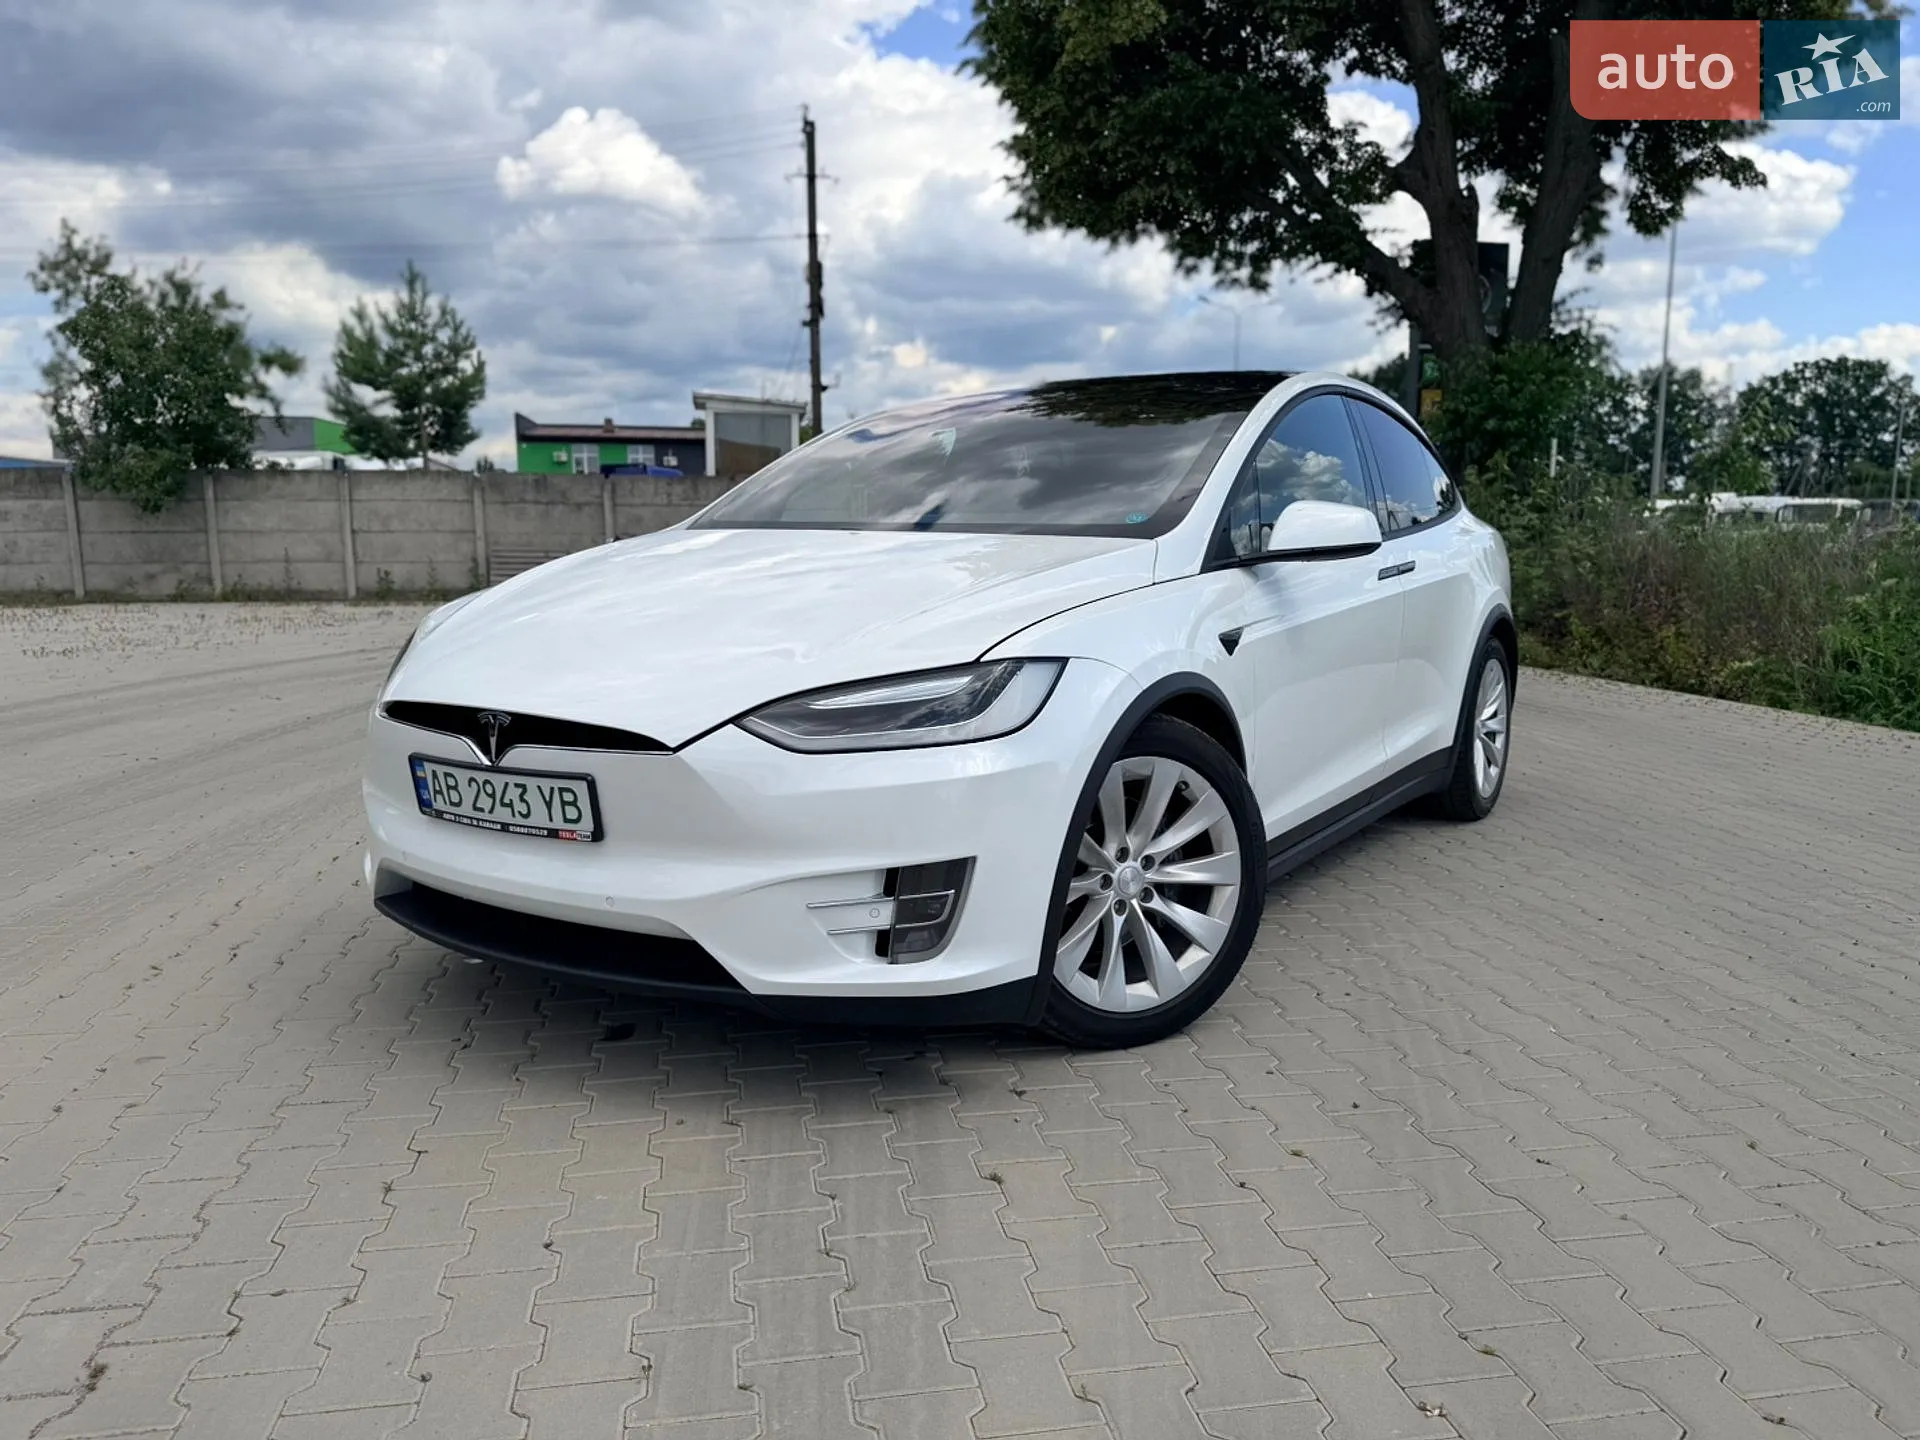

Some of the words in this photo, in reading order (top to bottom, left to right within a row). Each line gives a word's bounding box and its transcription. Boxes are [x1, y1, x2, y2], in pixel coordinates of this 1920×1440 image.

[431, 768, 464, 809] AB
[467, 776, 532, 820] 2943
[537, 784, 583, 825] YB
